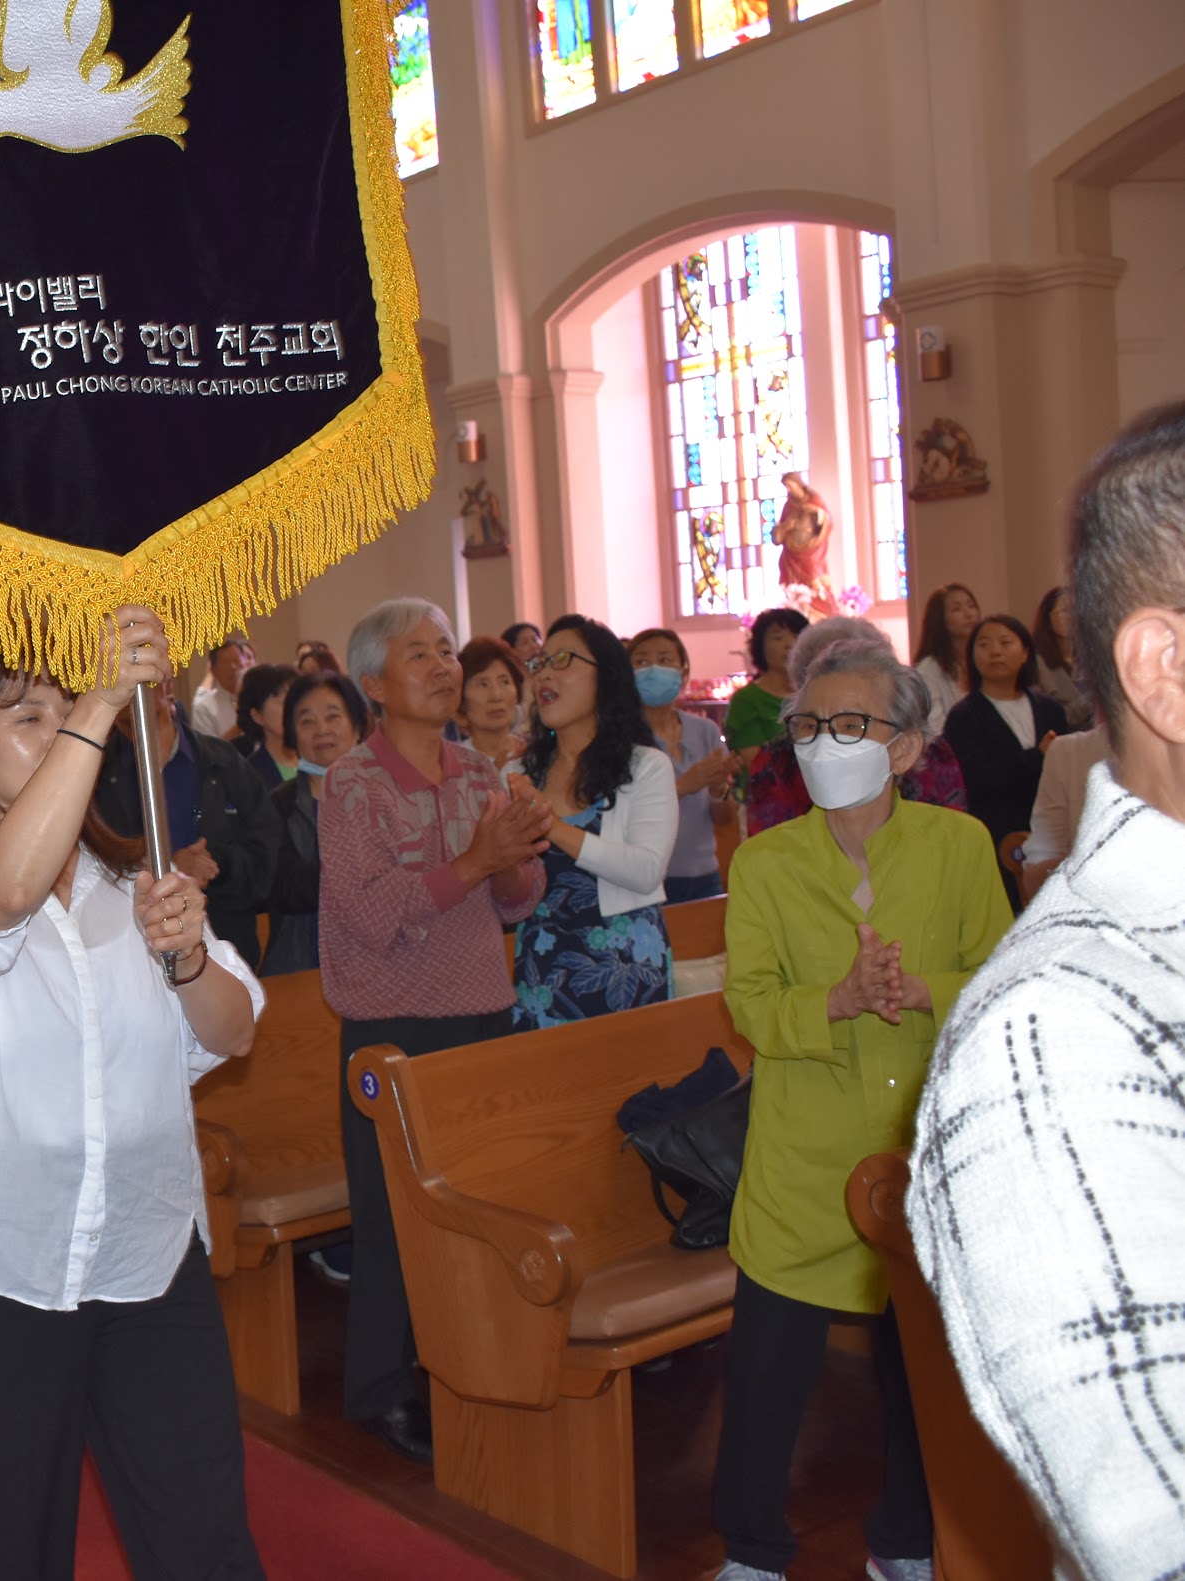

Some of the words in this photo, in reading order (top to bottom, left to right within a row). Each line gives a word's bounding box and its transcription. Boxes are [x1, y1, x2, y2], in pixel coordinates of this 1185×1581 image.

[17, 319, 124, 369] 정하상
[139, 321, 201, 367] 한인
[215, 320, 343, 367] 천주교회
[0, 380, 52, 404] PAUL
[55, 374, 128, 396] CHONG
[129, 375, 193, 396] KOREAN
[197, 376, 282, 397] CATHOLIC
[285, 371, 348, 392] CENTER
[364, 1075, 375, 1096] 3
